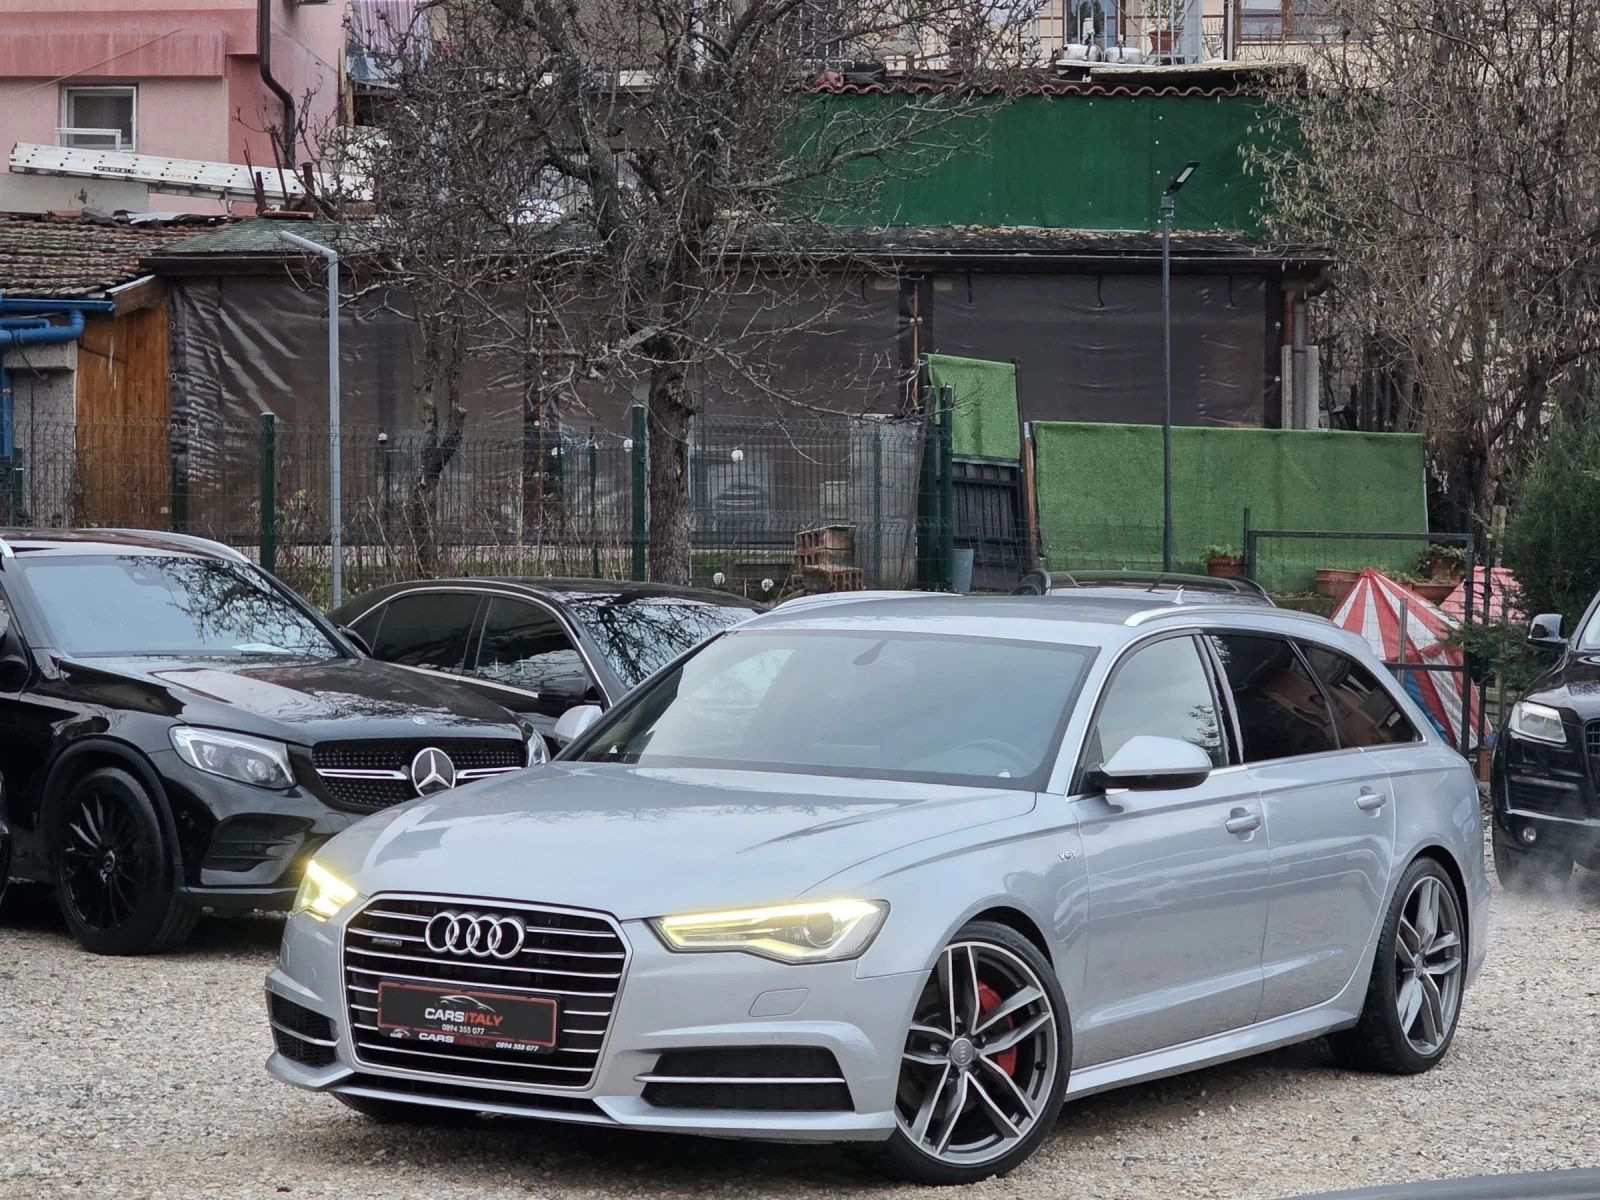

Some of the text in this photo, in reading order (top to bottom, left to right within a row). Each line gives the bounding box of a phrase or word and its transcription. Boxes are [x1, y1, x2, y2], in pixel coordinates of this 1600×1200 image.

[425, 1008, 503, 1026] CARSITALY
[441, 1024, 458, 1032] 0894
[459, 1026, 471, 1034] 355
